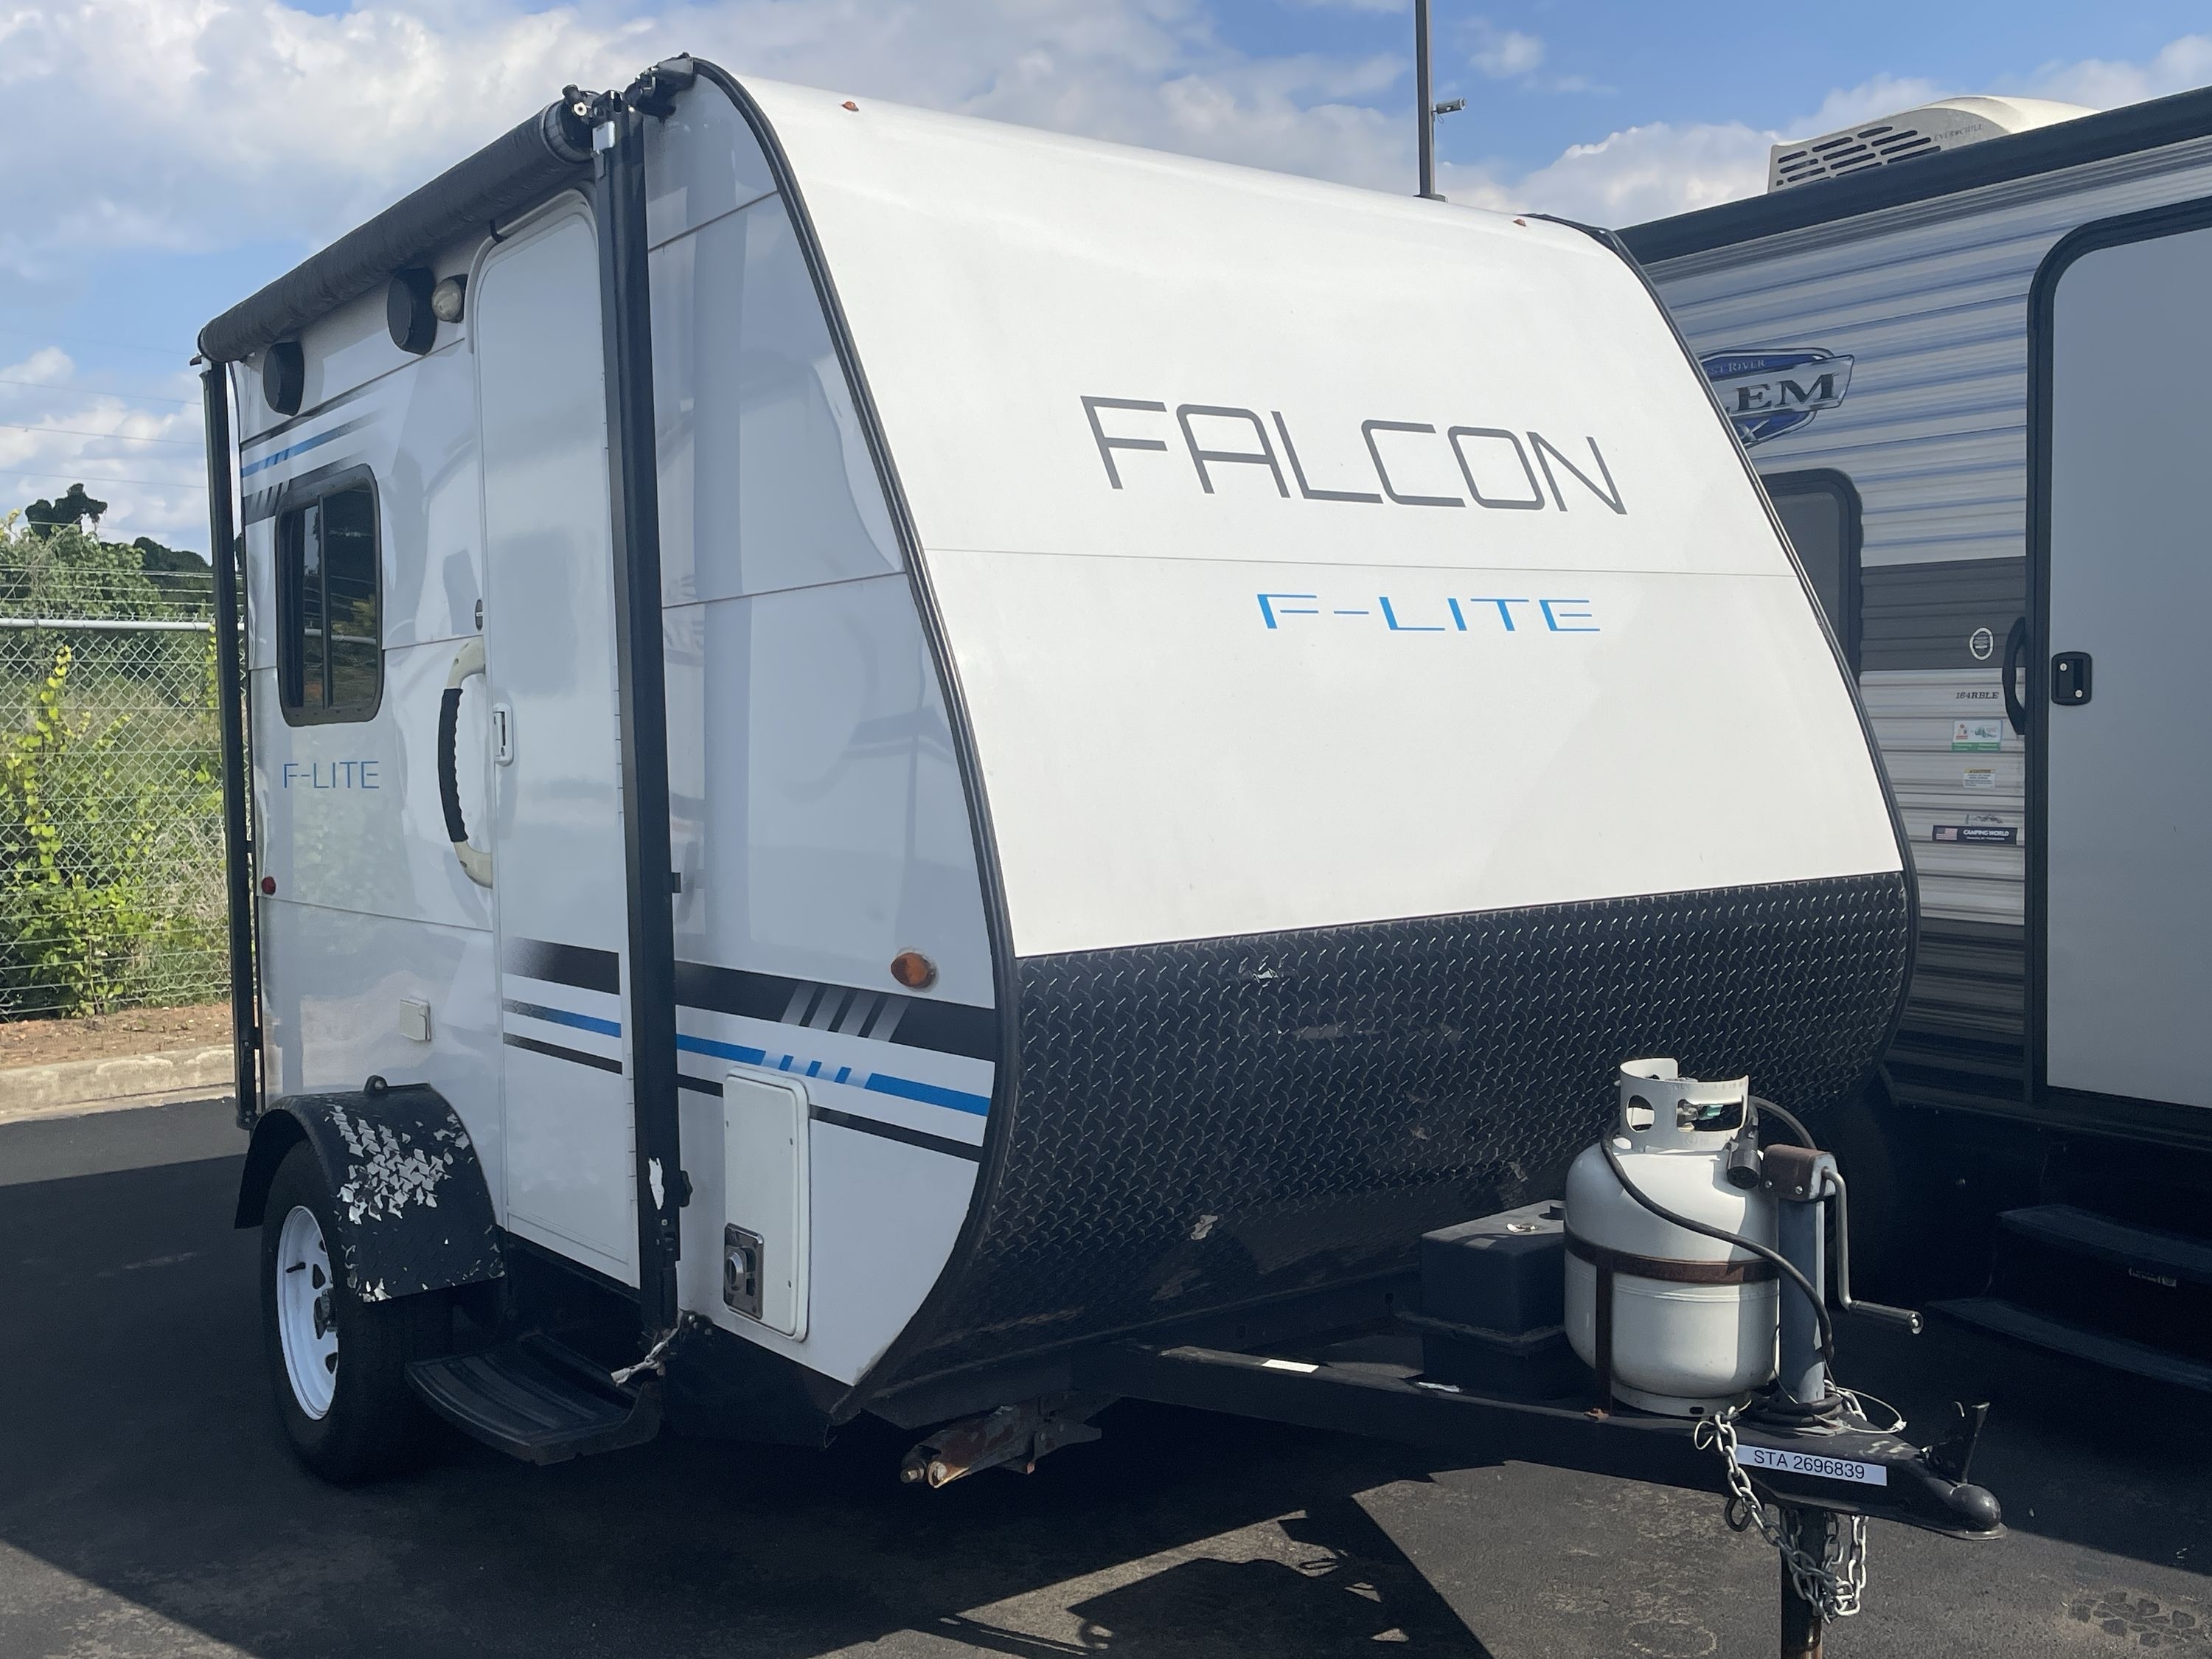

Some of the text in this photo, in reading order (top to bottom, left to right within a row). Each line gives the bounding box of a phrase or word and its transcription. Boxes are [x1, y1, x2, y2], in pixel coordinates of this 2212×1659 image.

[1728, 359, 1765, 372] RIVER
[1728, 372, 1840, 414] EM
[1080, 395, 1627, 515] FALCON
[1256, 594, 1601, 632] F-LITE
[283, 760, 380, 789] F-LITE
[1754, 1450, 1865, 1479] STA 2696839
